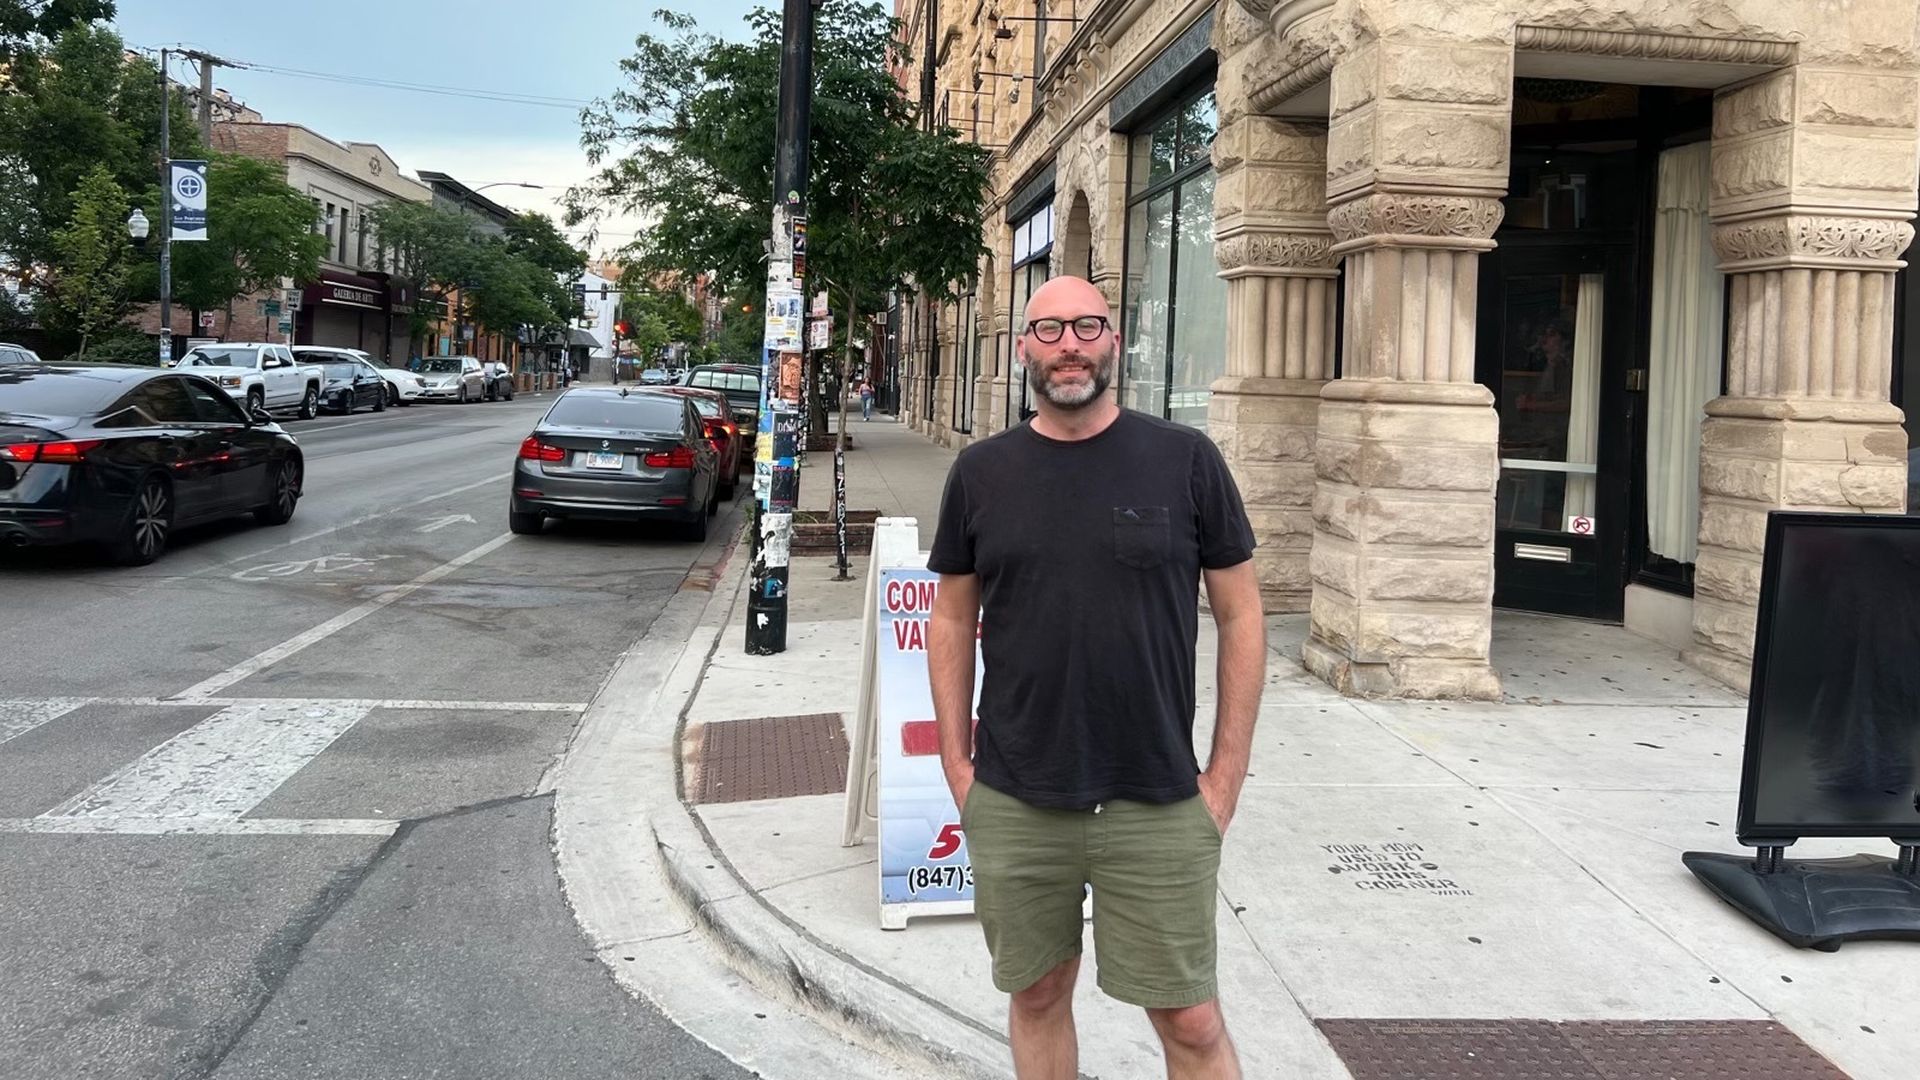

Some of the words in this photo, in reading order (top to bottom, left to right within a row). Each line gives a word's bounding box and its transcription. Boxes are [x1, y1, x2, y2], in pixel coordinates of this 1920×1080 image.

[333, 288, 354, 300] GALERIA
[362, 293, 374, 304] ARTE
[886, 580, 941, 612] COM
[893, 620, 929, 650] VA
[928, 823, 961, 860] 5
[1319, 844, 1373, 853] YOUR
[1380, 842, 1425, 852] MOM
[1338, 854, 1388, 863] USED
[1392, 852, 1422, 862] TO
[1336, 862, 1416, 872] WORK
[908, 866, 974, 894] (847)3
[1368, 871, 1427, 880] THIS
[1355, 880, 1459, 889] CORNER
